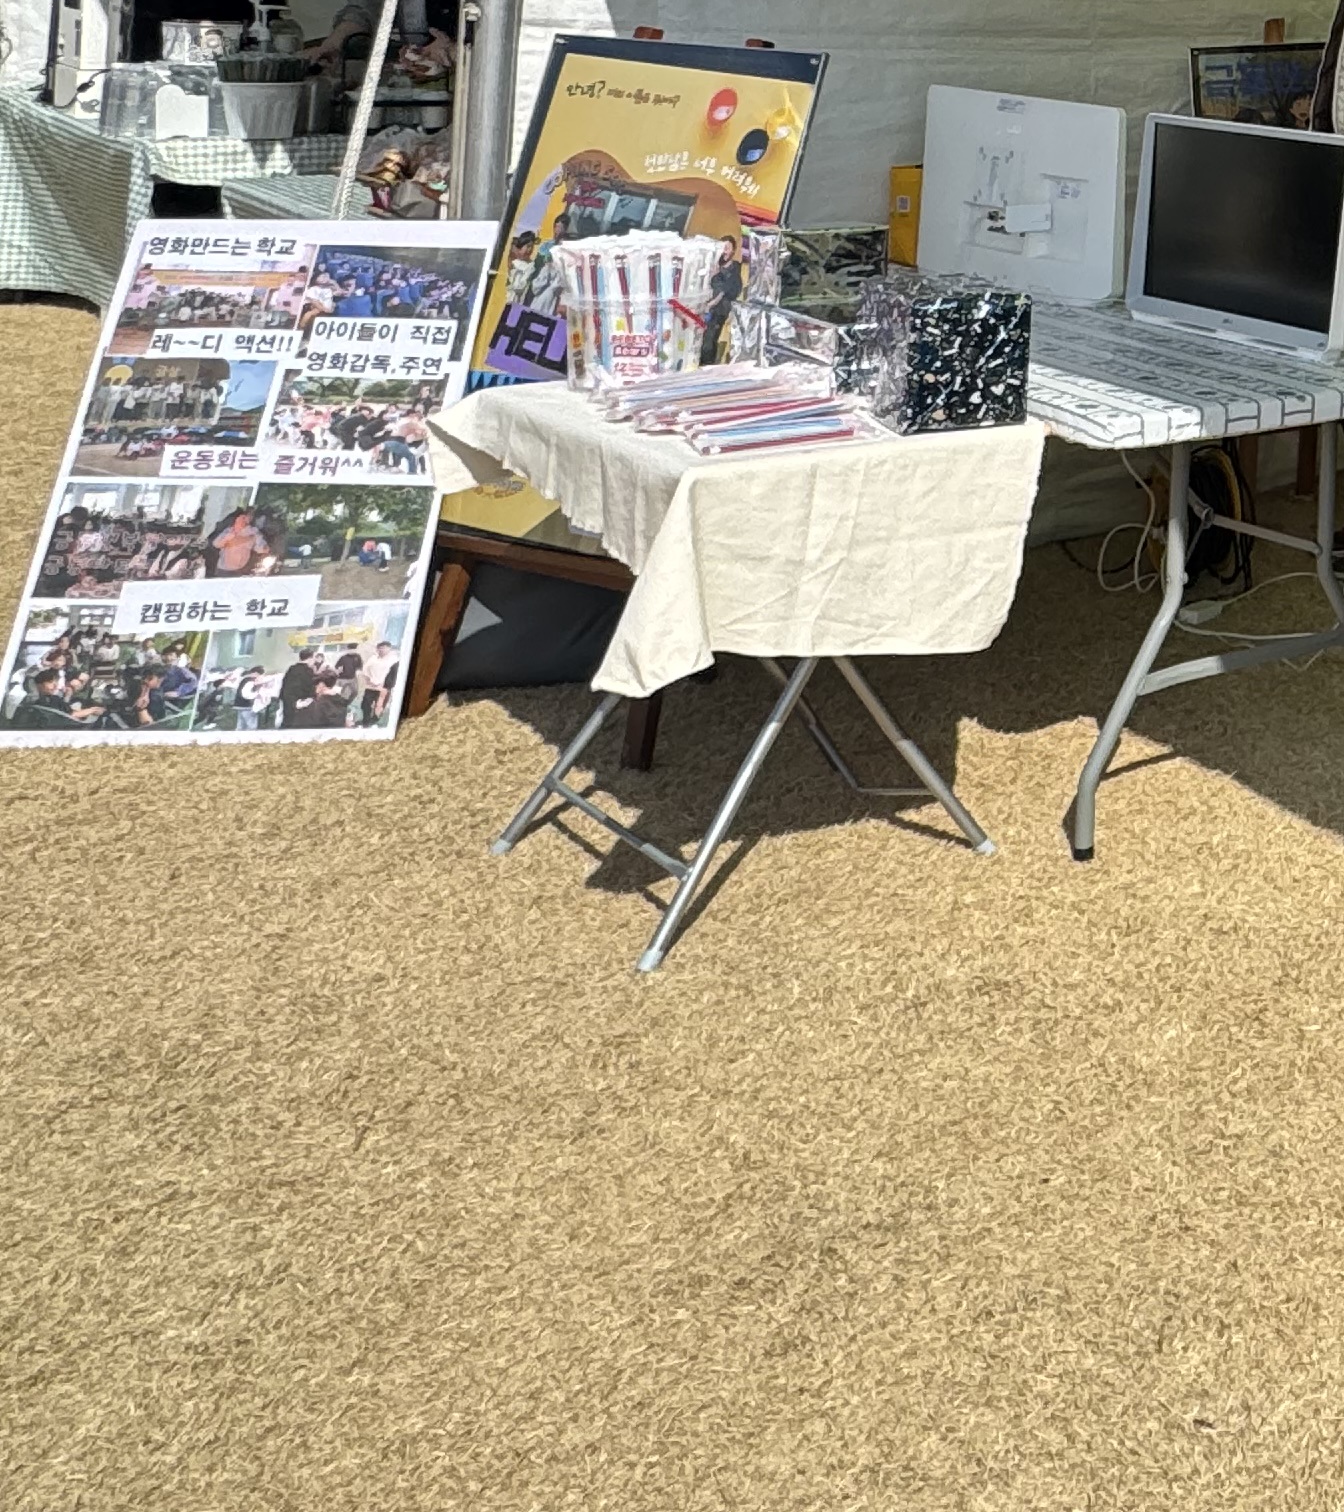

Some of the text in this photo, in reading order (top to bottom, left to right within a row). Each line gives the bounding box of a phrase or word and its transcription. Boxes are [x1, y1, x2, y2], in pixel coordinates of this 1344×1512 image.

[234, 333, 294, 353] 액션!!
[314, 321, 453, 346] 아이들이 직접
[170, 451, 260, 471] 운동회는
[140, 598, 290, 624] 캠핑하는 학교
